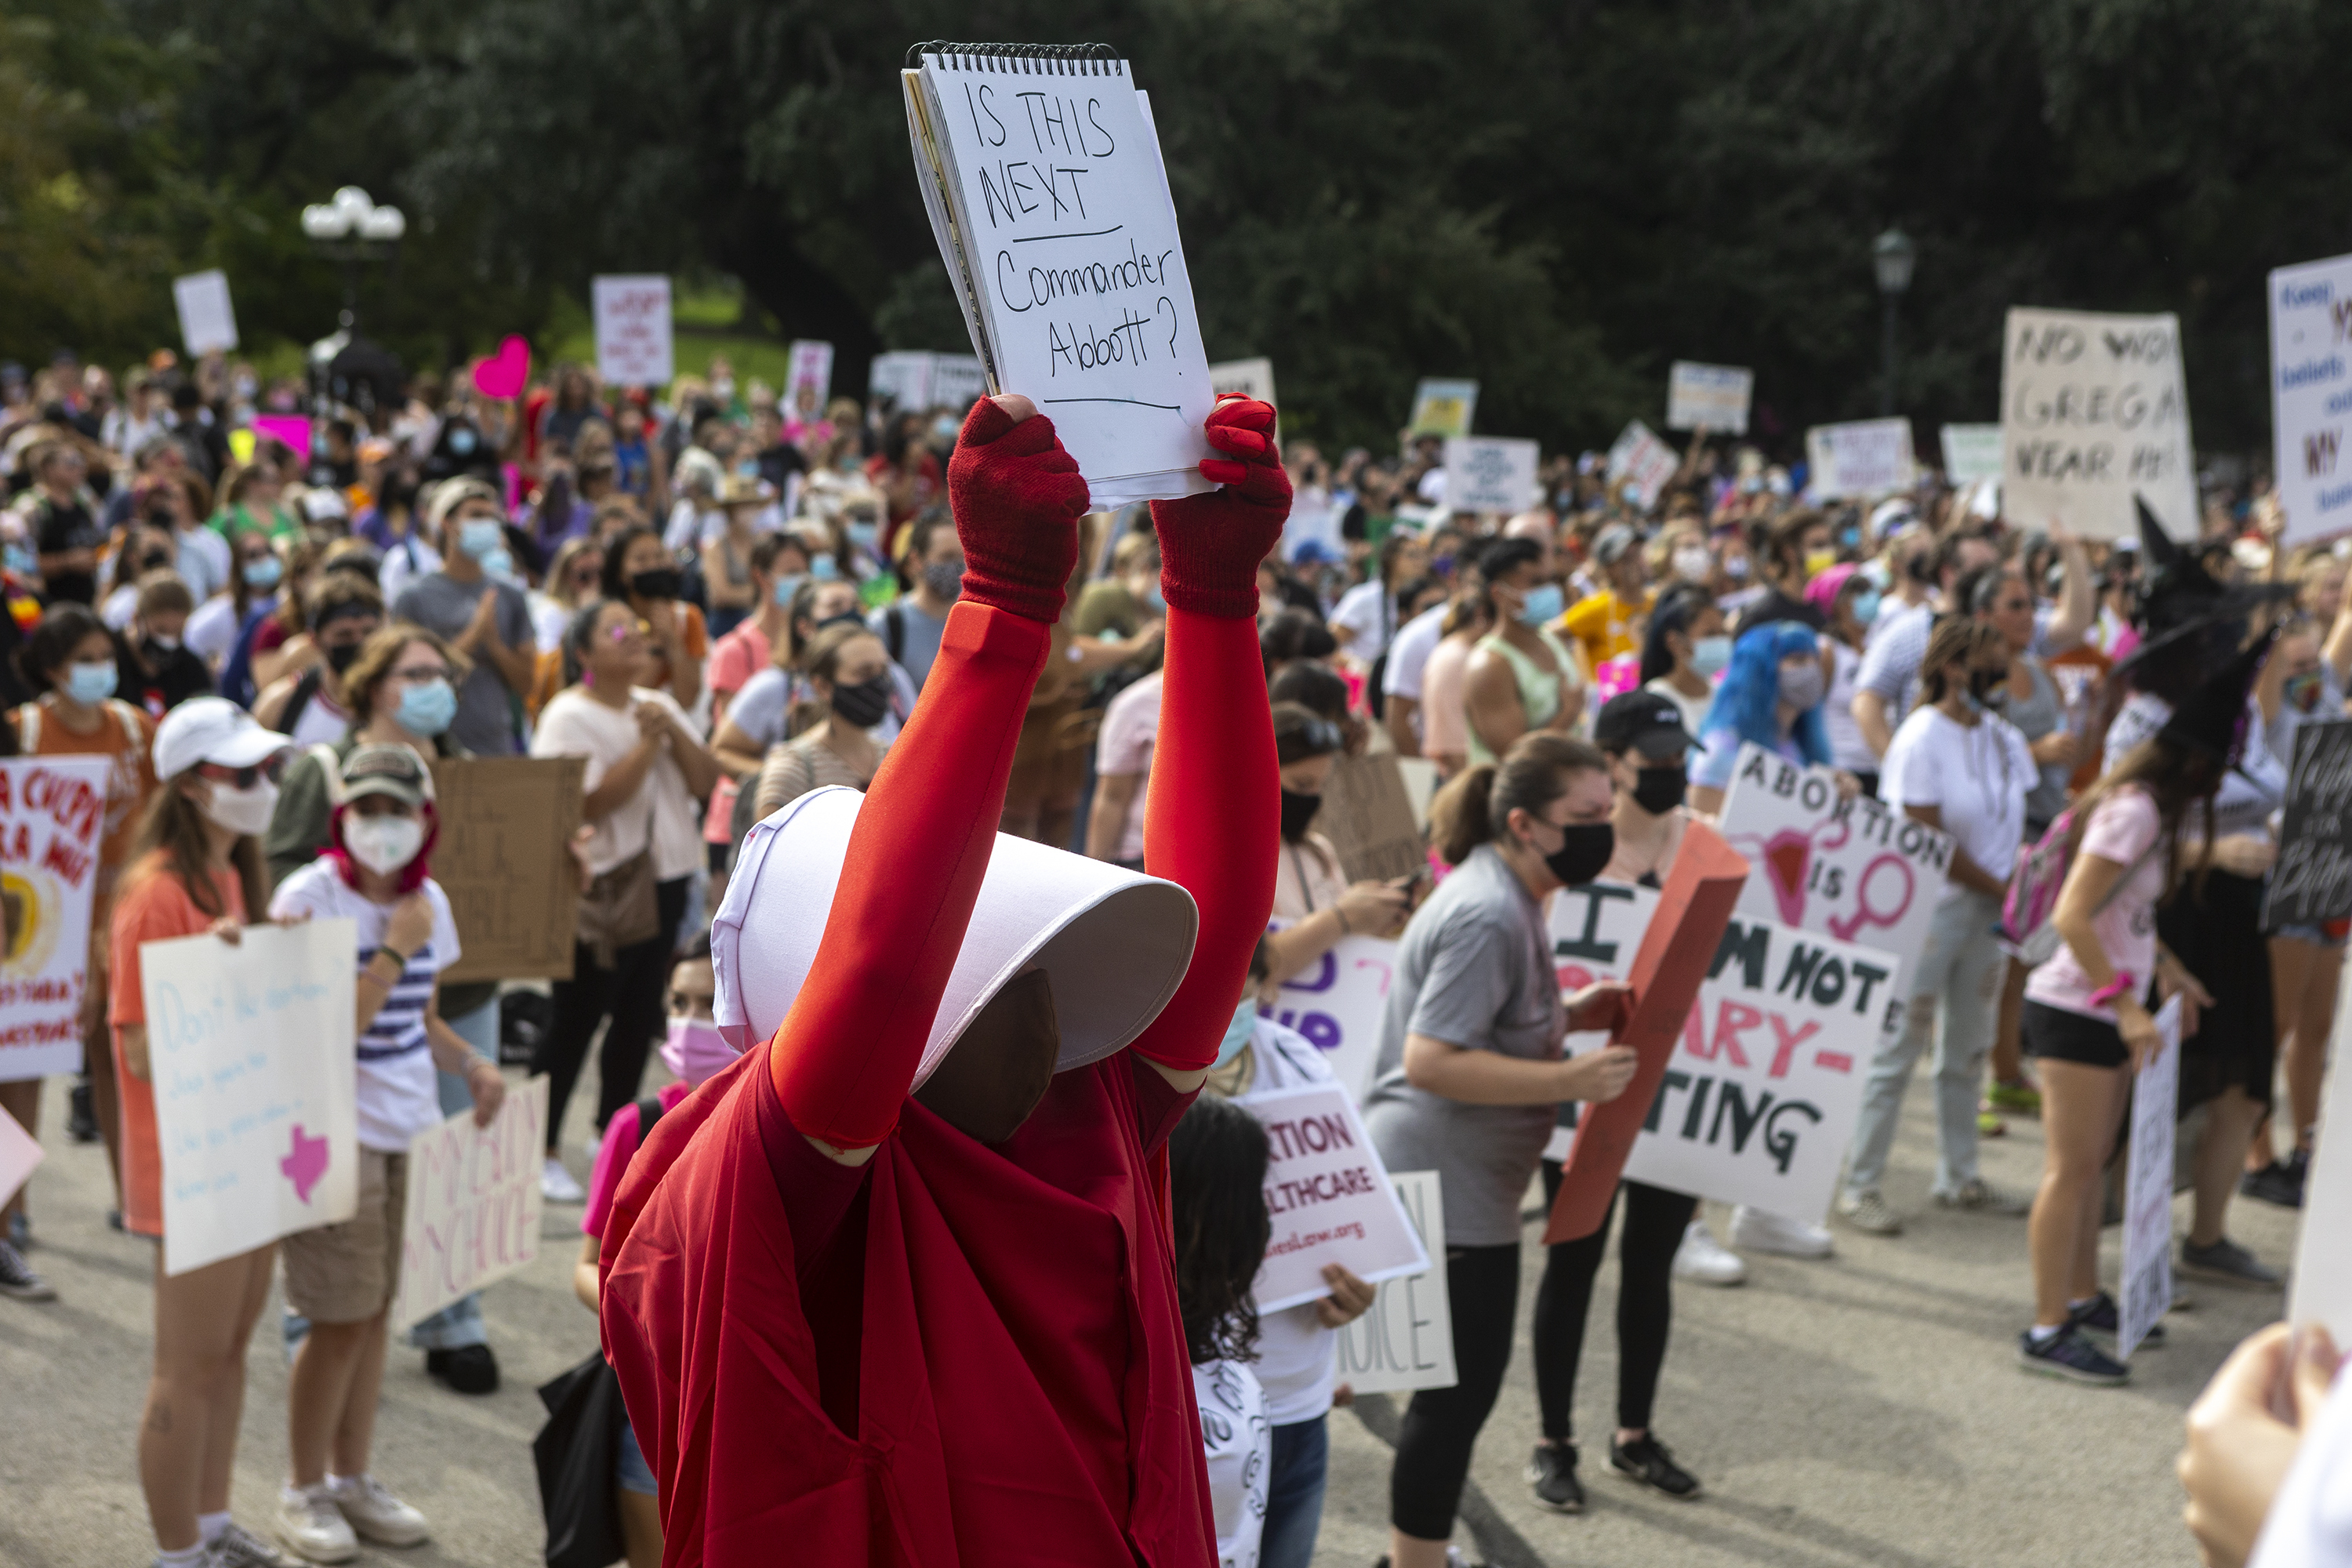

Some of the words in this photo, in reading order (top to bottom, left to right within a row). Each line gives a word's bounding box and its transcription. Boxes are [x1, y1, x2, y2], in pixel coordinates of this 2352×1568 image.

[964, 82, 1006, 147] IS
[1015, 91, 1115, 158] THIS
[979, 159, 1089, 228] NEXT
[996, 238, 1173, 313] Commander
[1049, 296, 1184, 378] Abbott?
[2013, 322, 2087, 366] NO
[1740, 751, 1951, 874] ABORTION
[1809, 856, 1844, 899] IS
[1555, 883, 1635, 964] I
[1708, 918, 1770, 991] M
[1777, 940, 1888, 1014] NOT
[1265, 1164, 1376, 1214] LTHCARE
